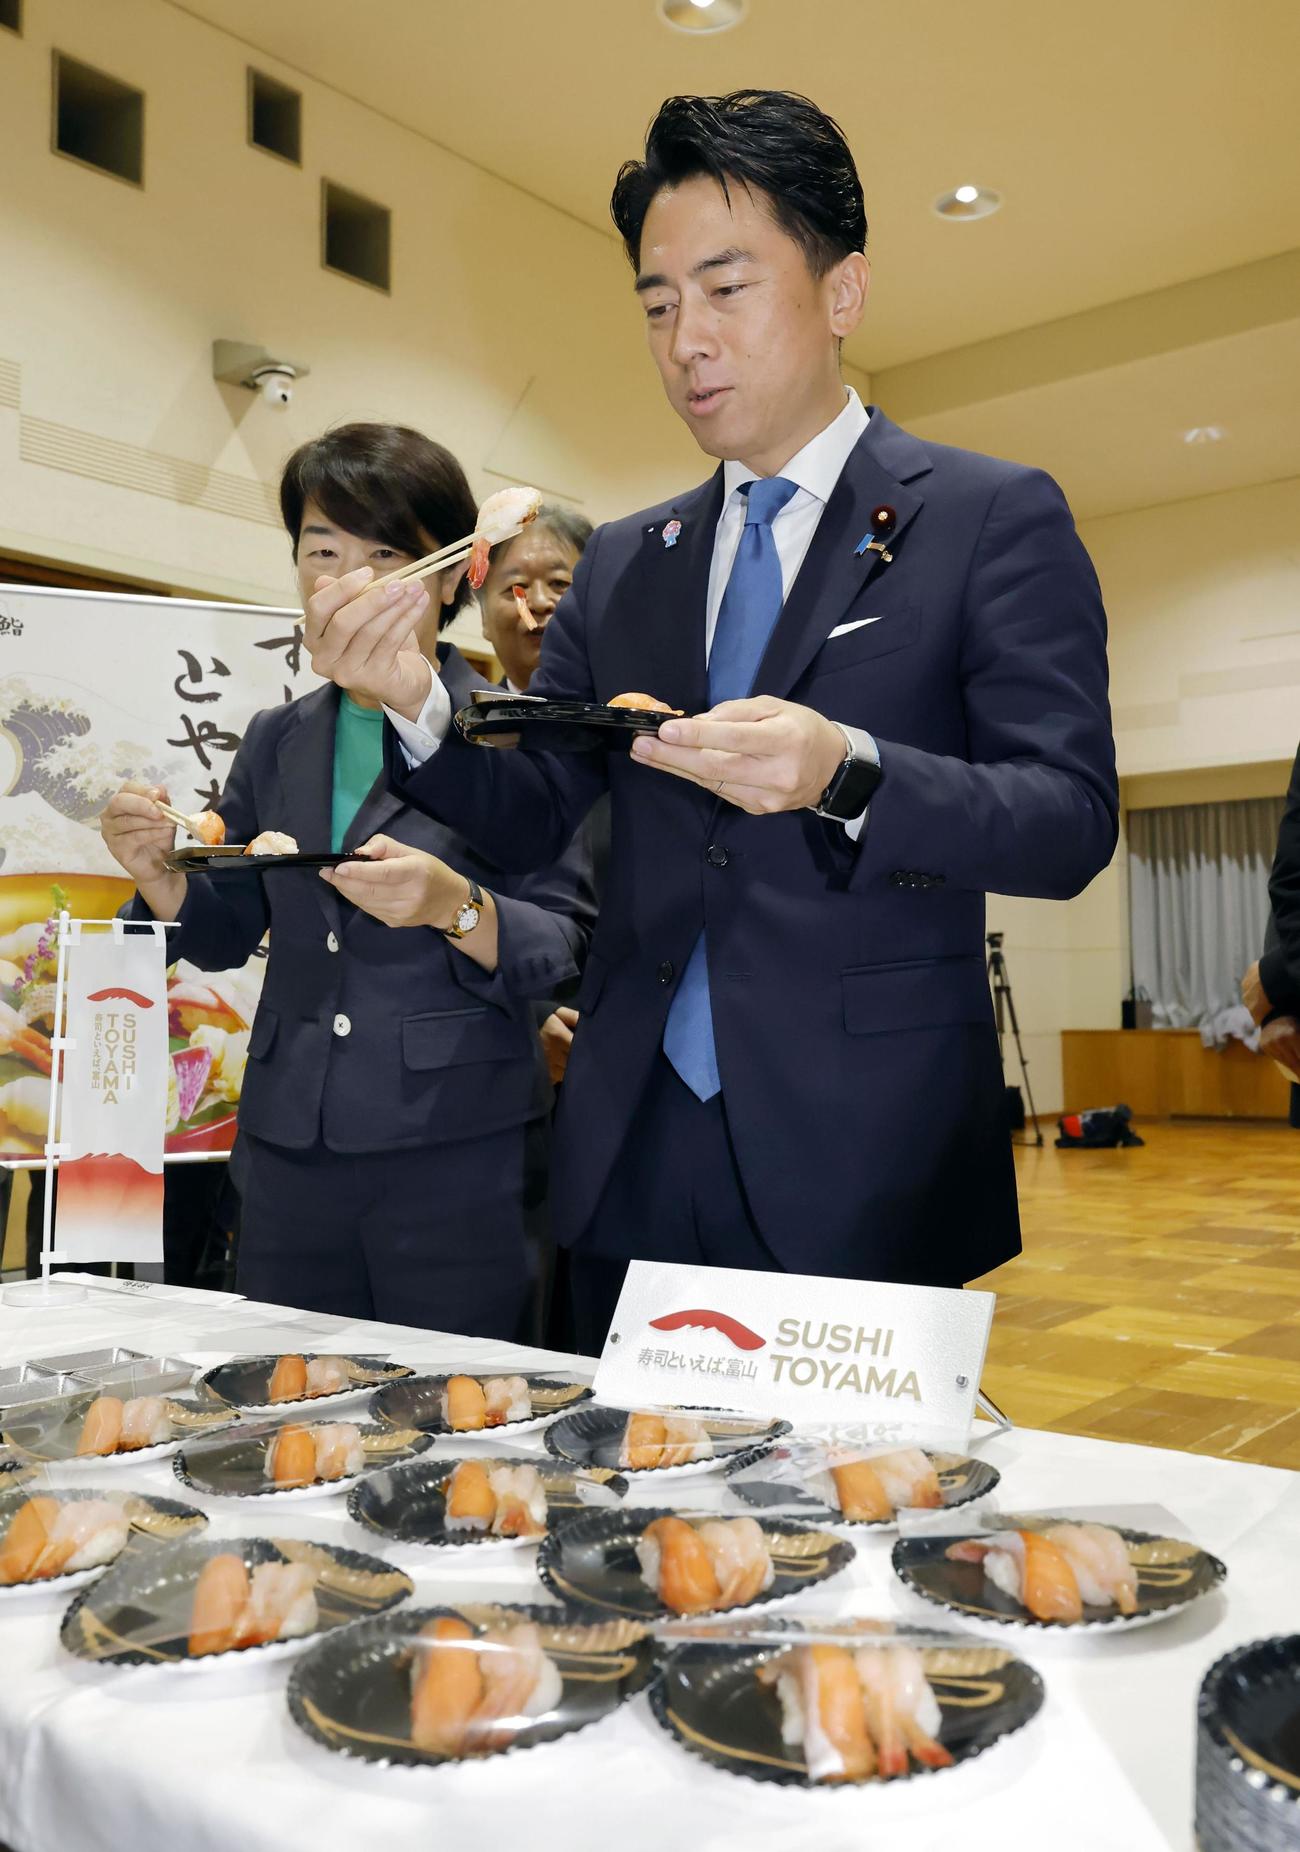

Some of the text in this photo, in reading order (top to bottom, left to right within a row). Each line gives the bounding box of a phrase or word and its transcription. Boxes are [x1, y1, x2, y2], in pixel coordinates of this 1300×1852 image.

[102, 1013, 120, 1105] TOYAMA
[122, 1013, 137, 1090] SUSHI
[775, 1318, 894, 1357] SUSHI
[769, 1354, 922, 1402] TOYAMA
